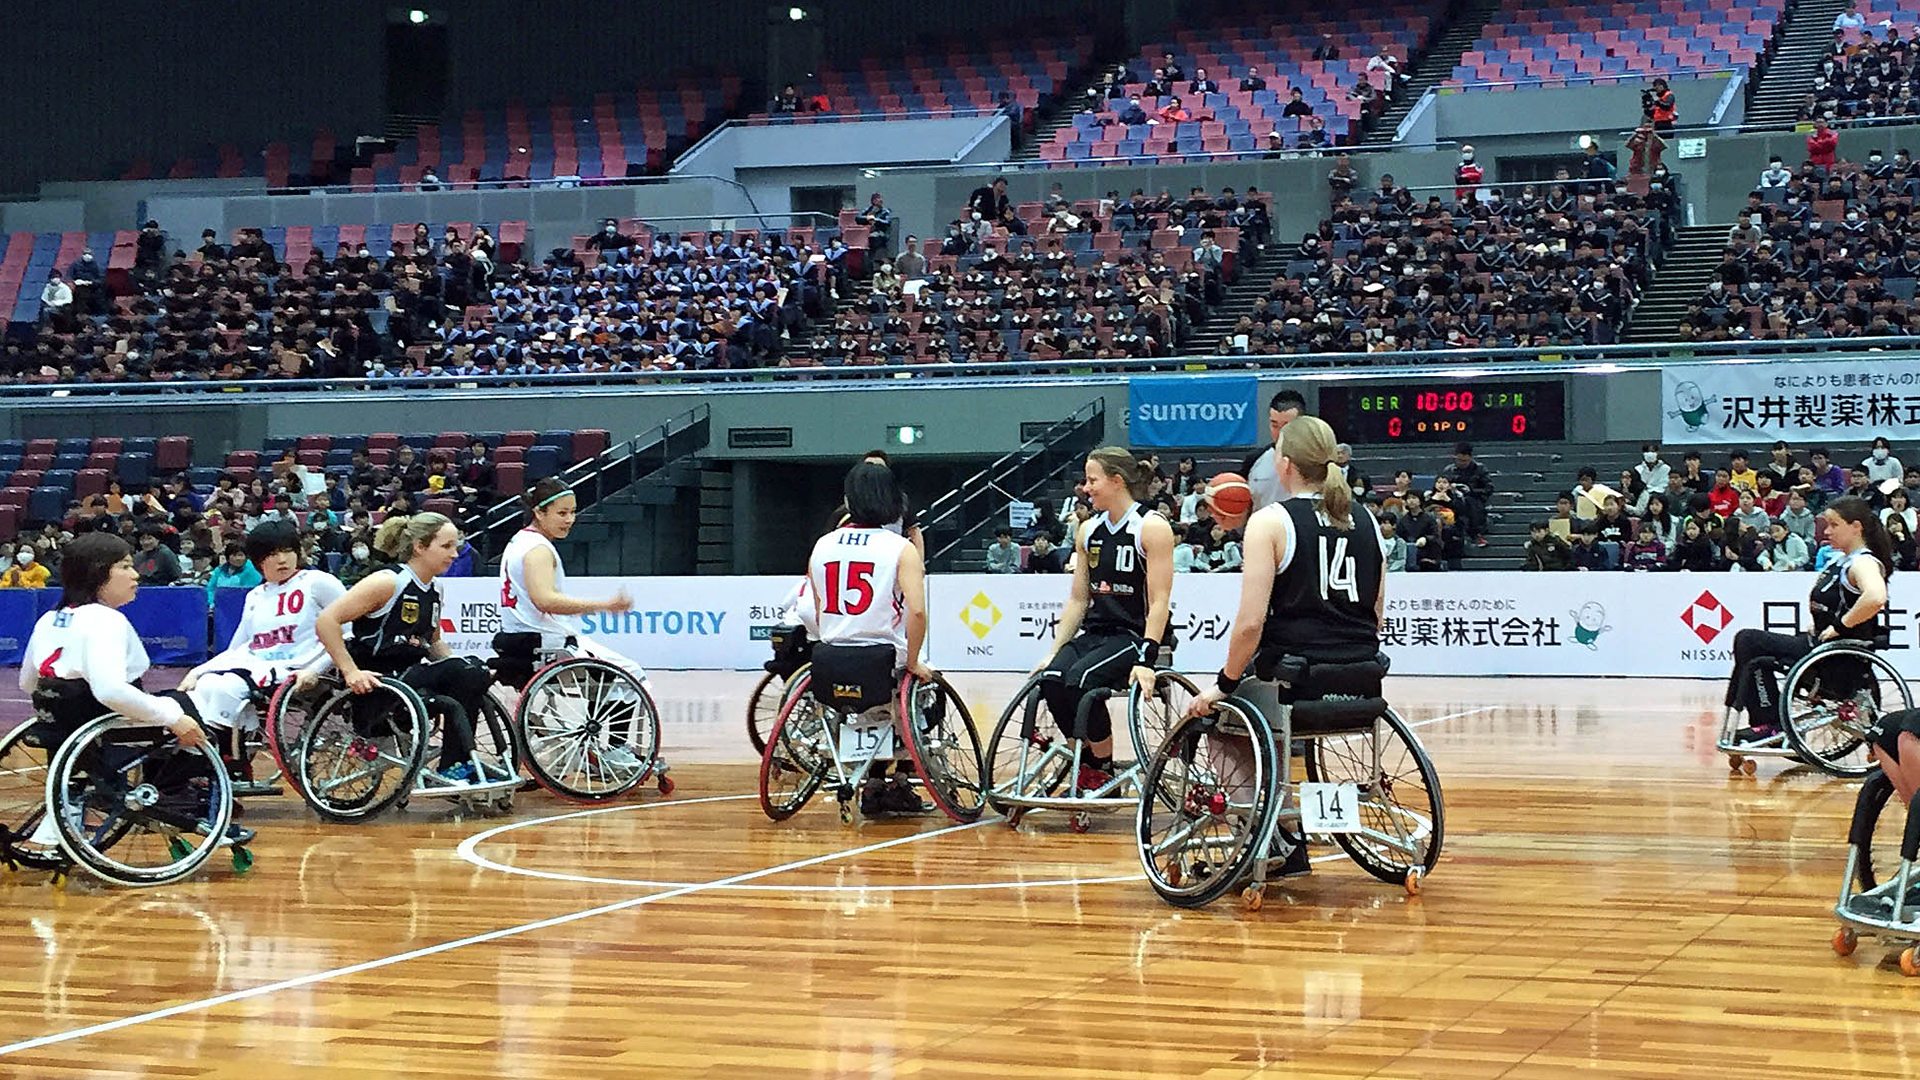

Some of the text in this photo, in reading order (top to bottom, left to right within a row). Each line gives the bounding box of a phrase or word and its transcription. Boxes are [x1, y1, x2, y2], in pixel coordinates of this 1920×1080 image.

[1361, 392, 1523, 411] GER 10:00 JPN
[1388, 417, 1402, 436] 0
[1512, 414, 1526, 434] 0
[838, 533, 870, 546] IHI
[1115, 545, 1135, 572] 10
[1318, 535, 1360, 602] 14
[822, 560, 876, 616] 15
[275, 589, 305, 617] 10
[1379, 616, 1562, 647] 製薬株式会社
[967, 645, 994, 656] NNC
[1681, 649, 1735, 660] NISSAY
[854, 726, 880, 751] 15
[1316, 789, 1344, 820] 14
